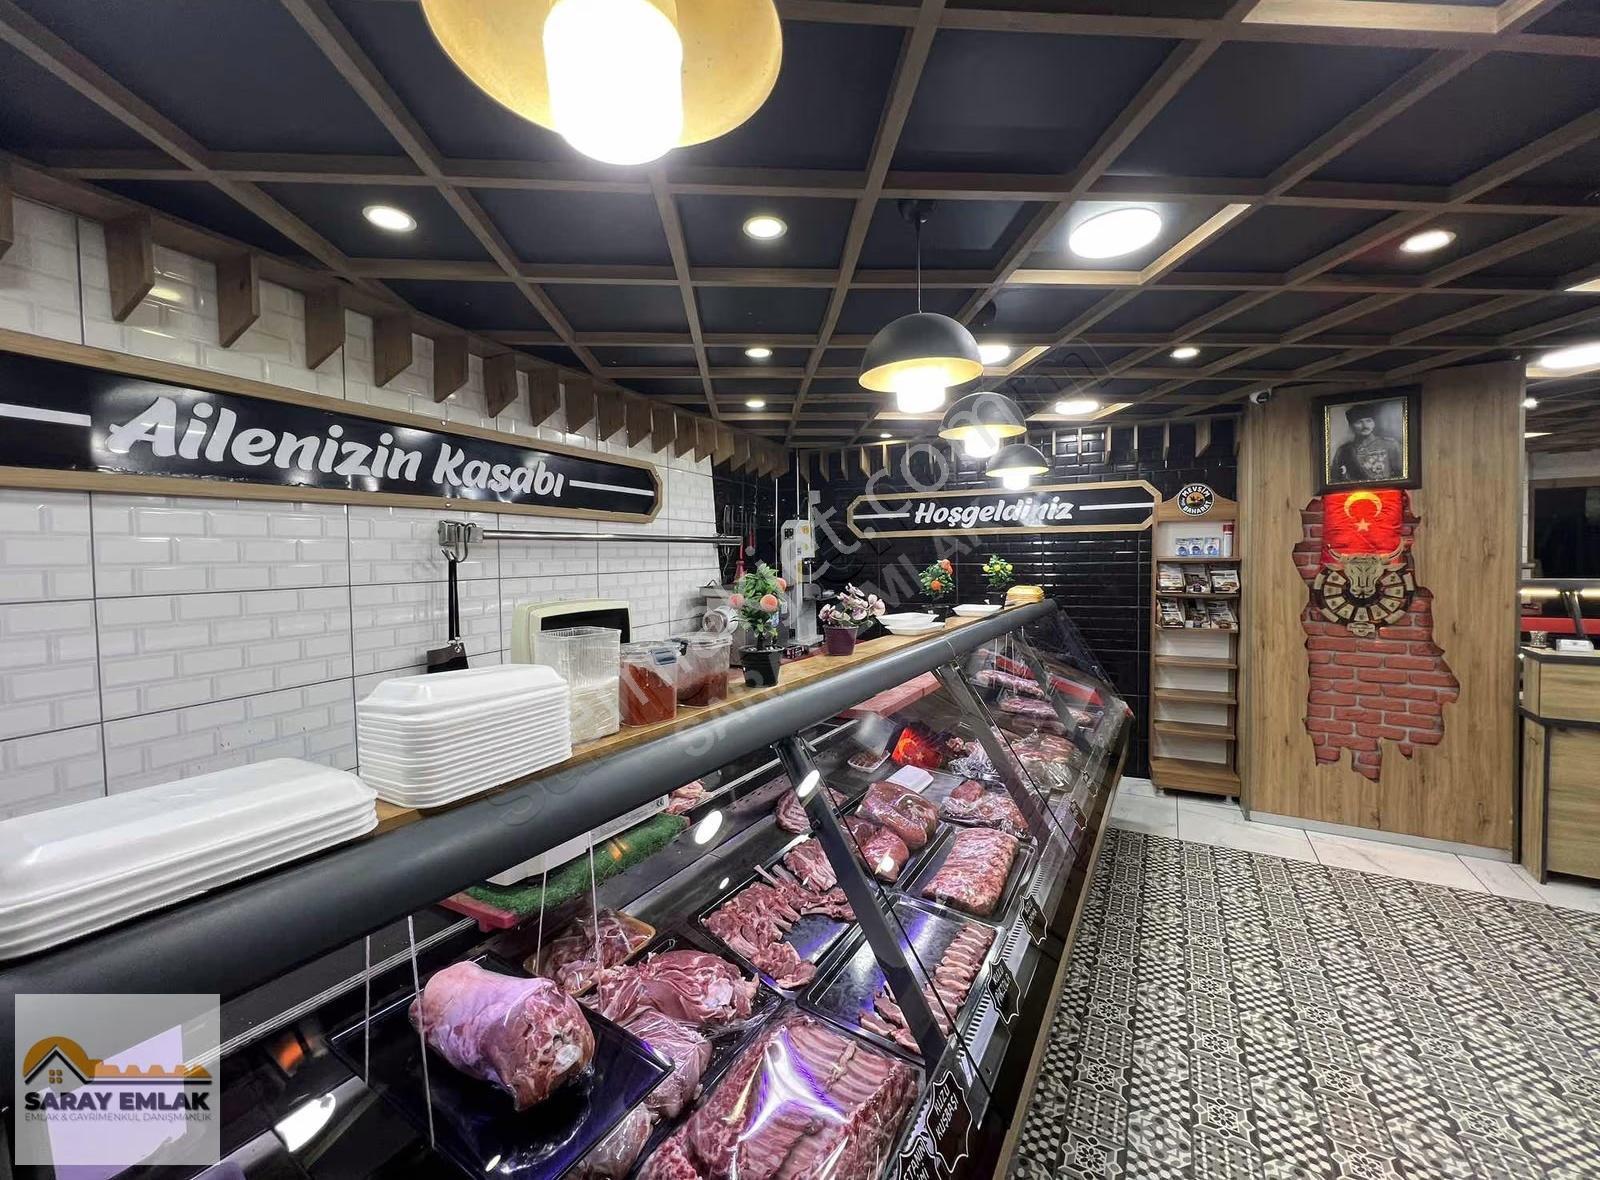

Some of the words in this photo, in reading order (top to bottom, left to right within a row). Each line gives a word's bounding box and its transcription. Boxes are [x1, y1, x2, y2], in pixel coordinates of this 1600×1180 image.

[107, 395, 424, 482] Ailenizin
[432, 443, 565, 498] Kasabı
[914, 496, 1075, 530] Hoşgeldiniz
[1183, 500, 1211, 514] BAHARAT
[933, 1083, 950, 1116] KUZU
[935, 1093, 959, 1140] KUŞBAŞI
